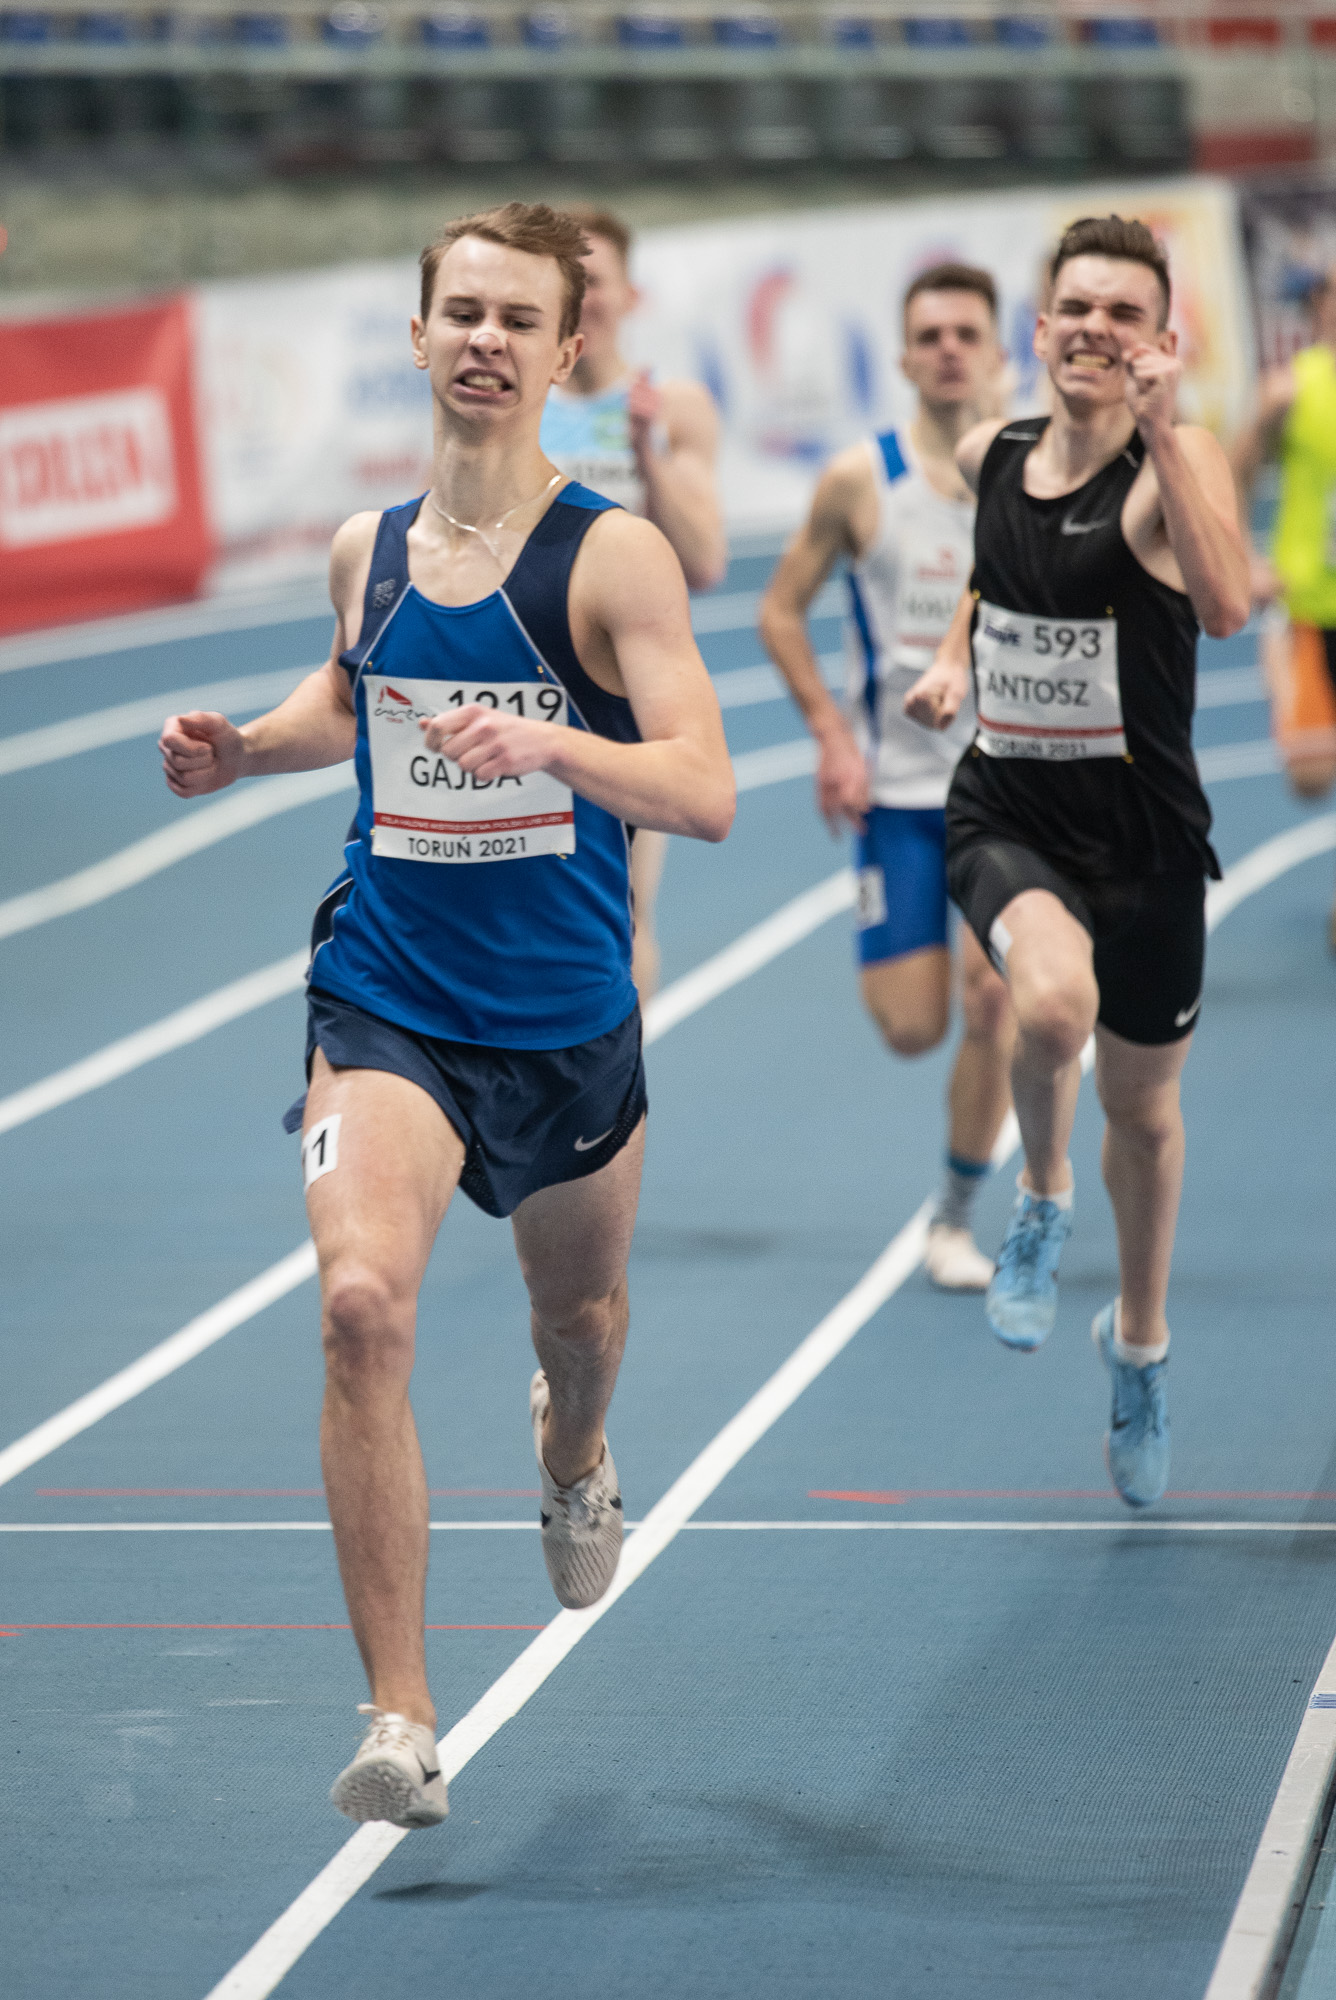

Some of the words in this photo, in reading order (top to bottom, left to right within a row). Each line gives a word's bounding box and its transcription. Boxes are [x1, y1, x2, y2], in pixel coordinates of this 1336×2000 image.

[1034, 624, 1101, 659] 593
[987, 671, 1089, 708] ANTOSZ
[408, 836, 471, 859] TORUŃ
[480, 836, 526, 857] 2021
